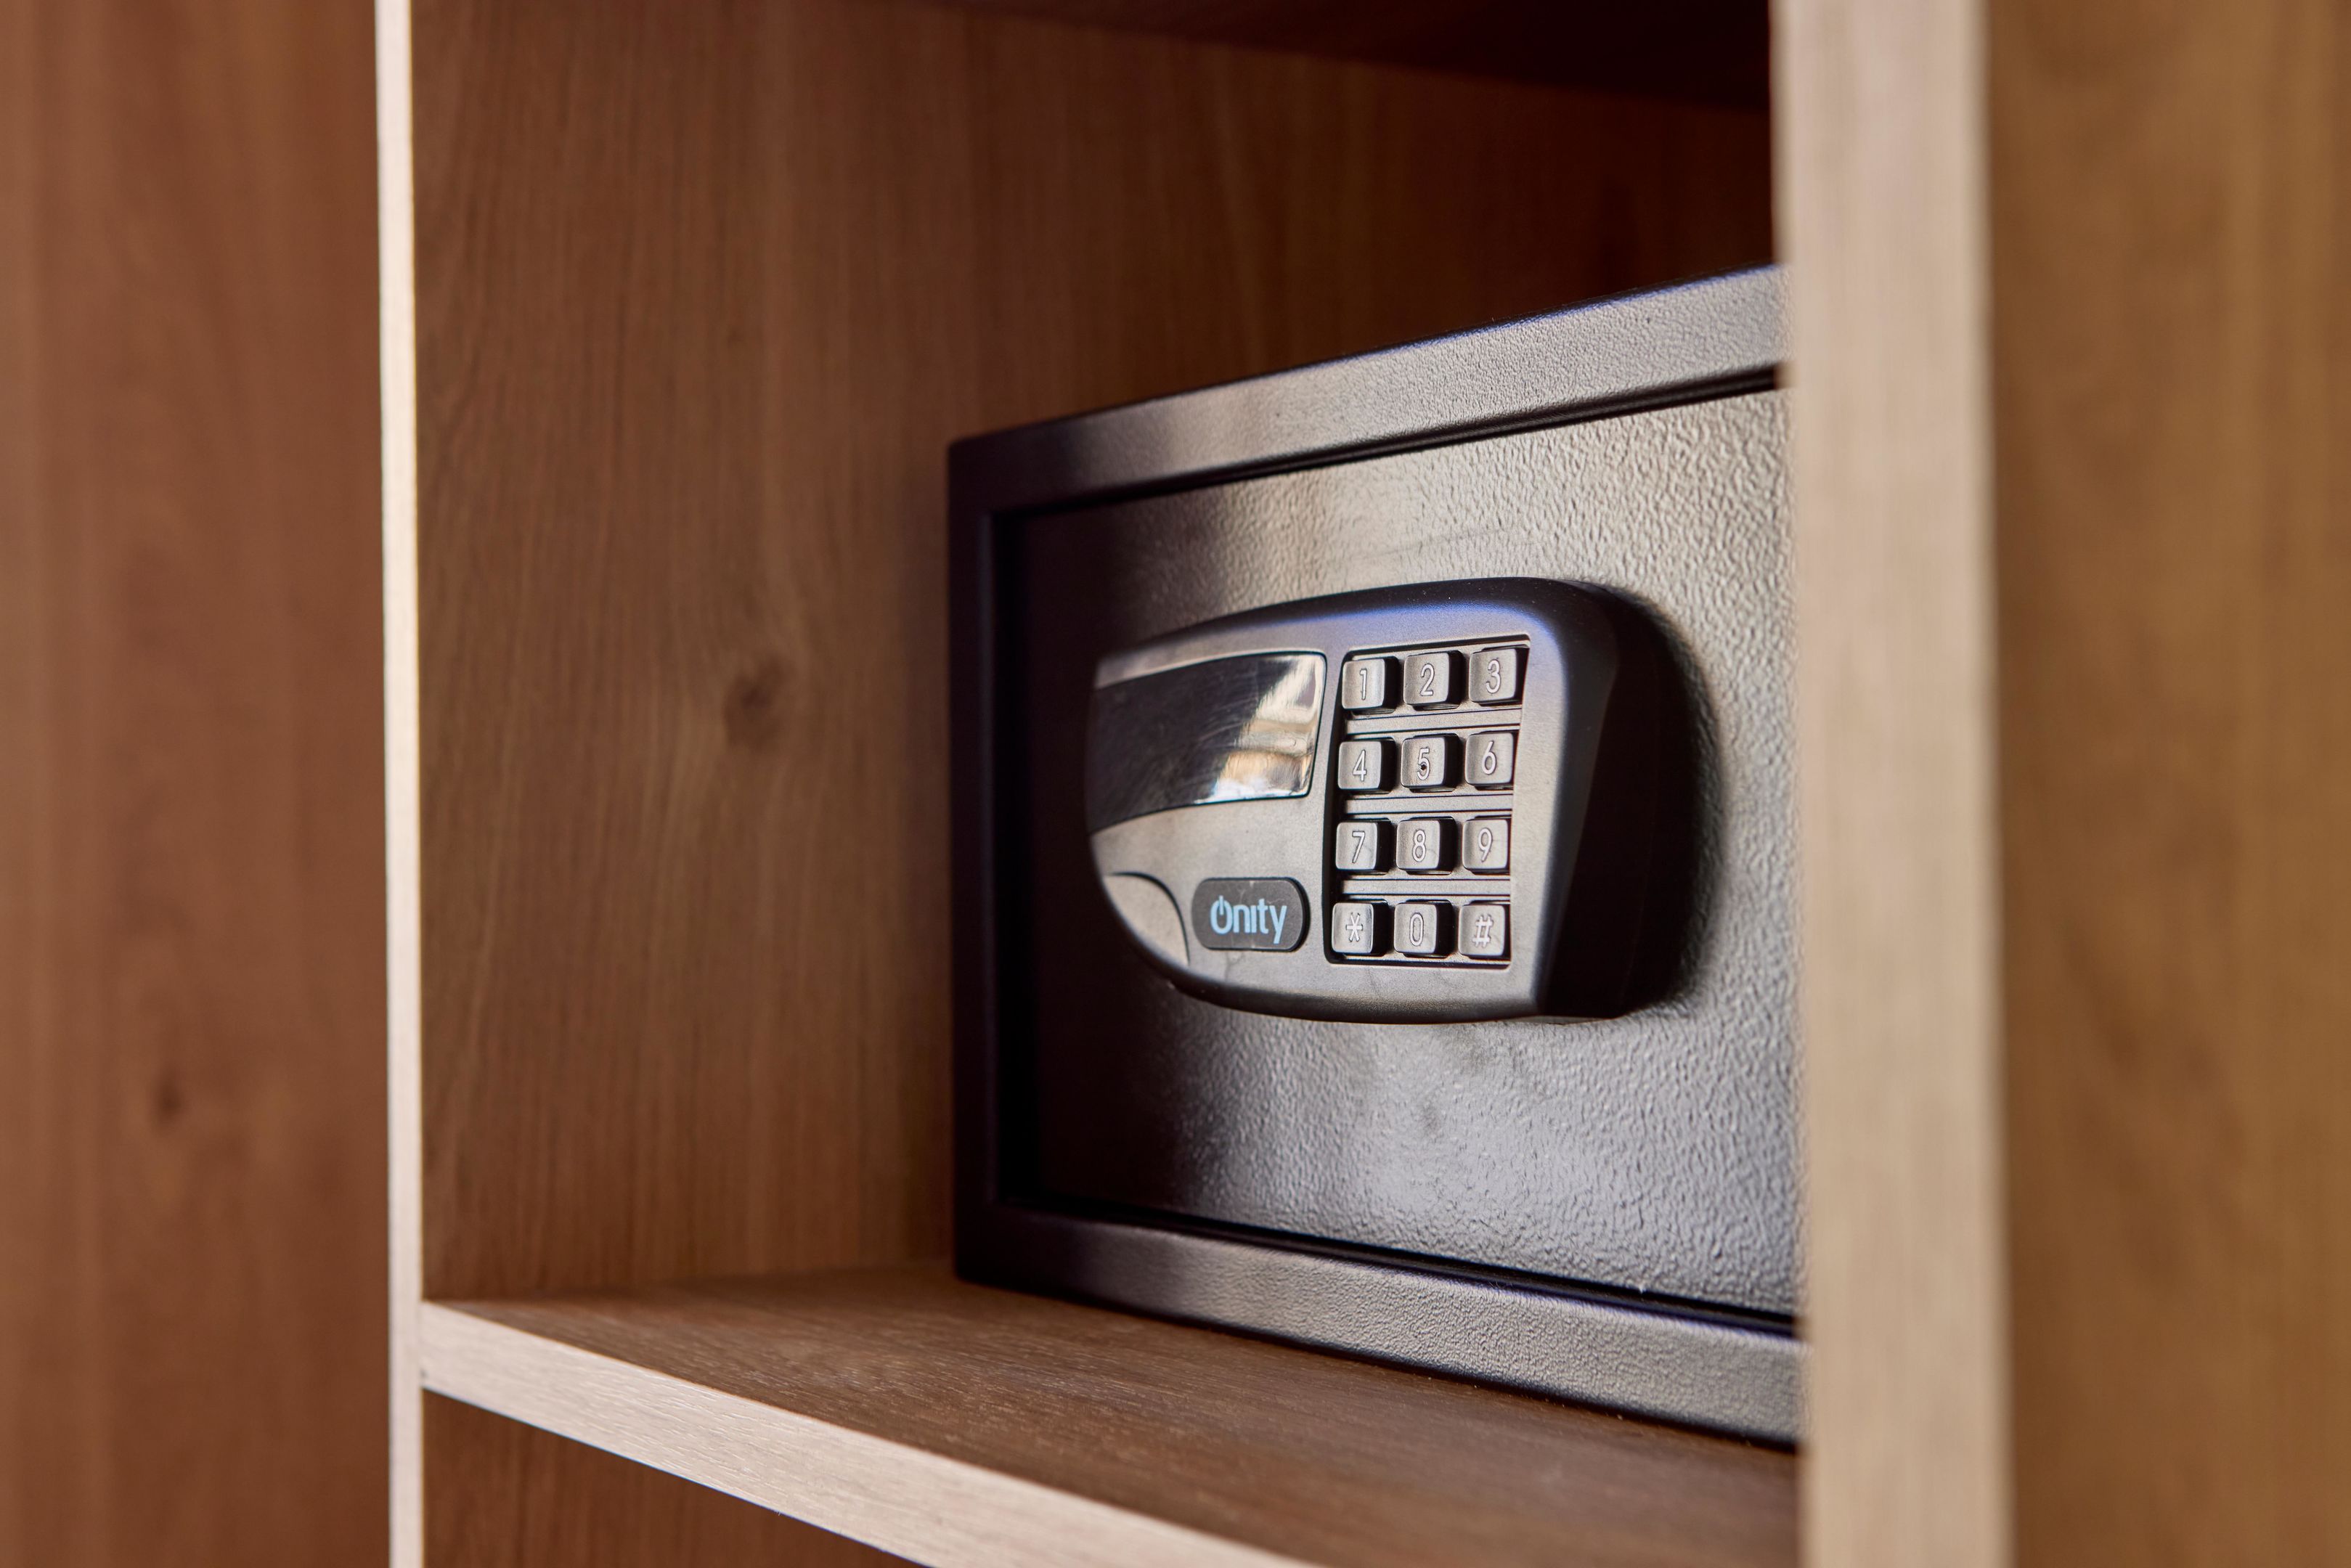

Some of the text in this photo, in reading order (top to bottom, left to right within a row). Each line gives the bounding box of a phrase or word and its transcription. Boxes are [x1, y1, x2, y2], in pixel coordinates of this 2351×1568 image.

[1358, 659, 1502, 701] 1 2 3
[1352, 740, 1496, 781] 4 5 6
[1352, 827, 1493, 864] 7 8 9
[1210, 895, 1287, 944] Onity
[1472, 914, 1493, 948] #
